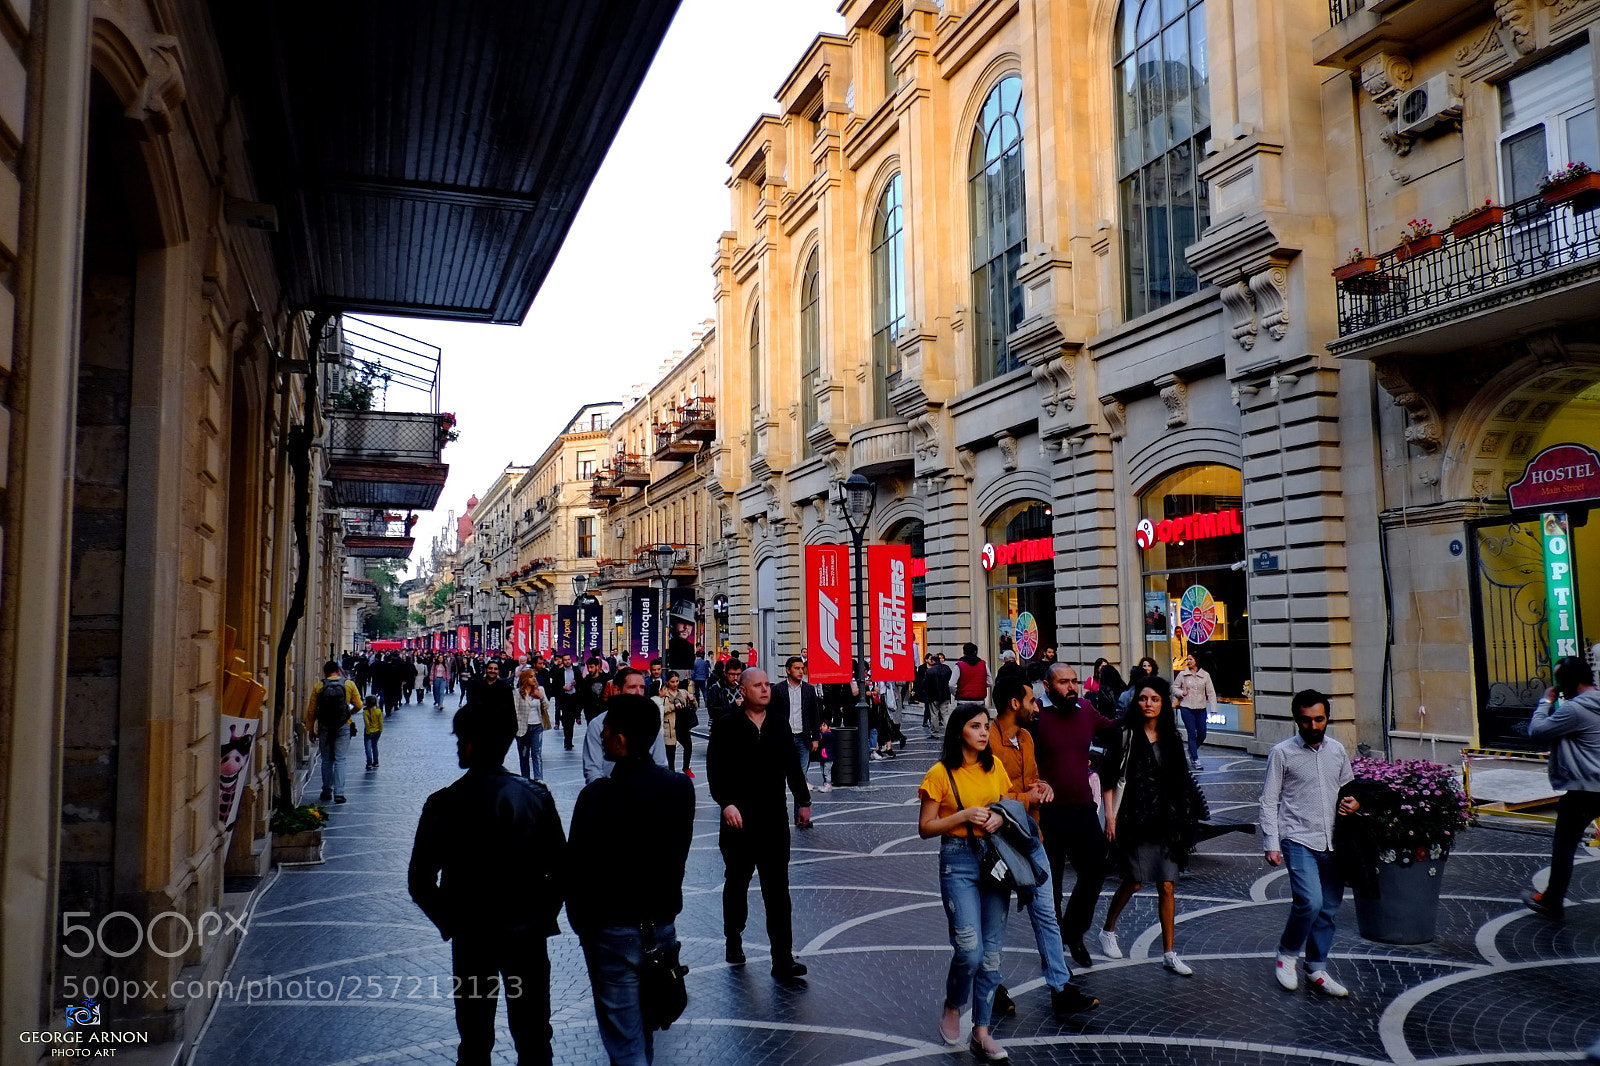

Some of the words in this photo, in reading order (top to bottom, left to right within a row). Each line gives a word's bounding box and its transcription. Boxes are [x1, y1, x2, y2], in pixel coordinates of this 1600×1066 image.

[1531, 463, 1594, 484] HOSTEL
[1541, 486, 1560, 495] Main
[1563, 483, 1585, 493] Street
[563, 618, 572, 638] Aprel
[640, 598, 653, 658] Jamiroquai
[879, 592, 894, 671] STREET
[563, 640, 571, 648] 27
